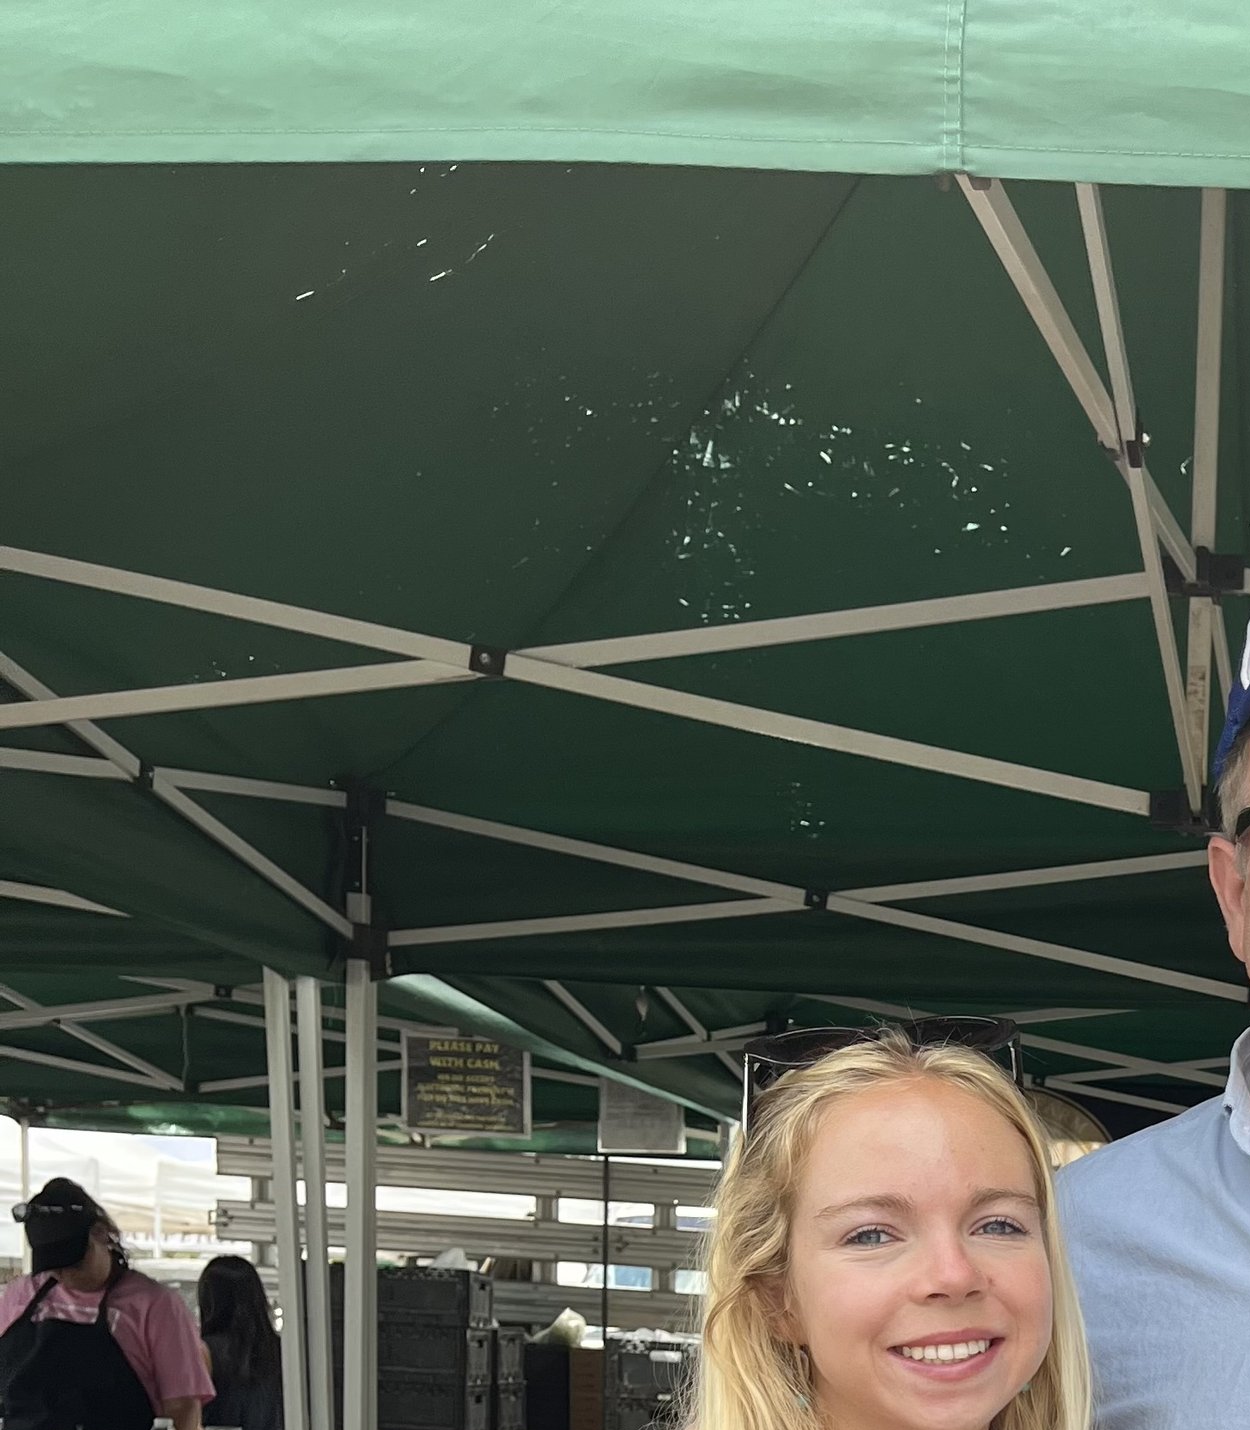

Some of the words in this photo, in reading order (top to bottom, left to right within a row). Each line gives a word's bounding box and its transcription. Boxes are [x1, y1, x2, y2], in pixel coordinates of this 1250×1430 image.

[430, 1040, 472, 1052] PLEASE
[475, 1042, 499, 1053] PAY
[429, 1056, 464, 1067] WITH
